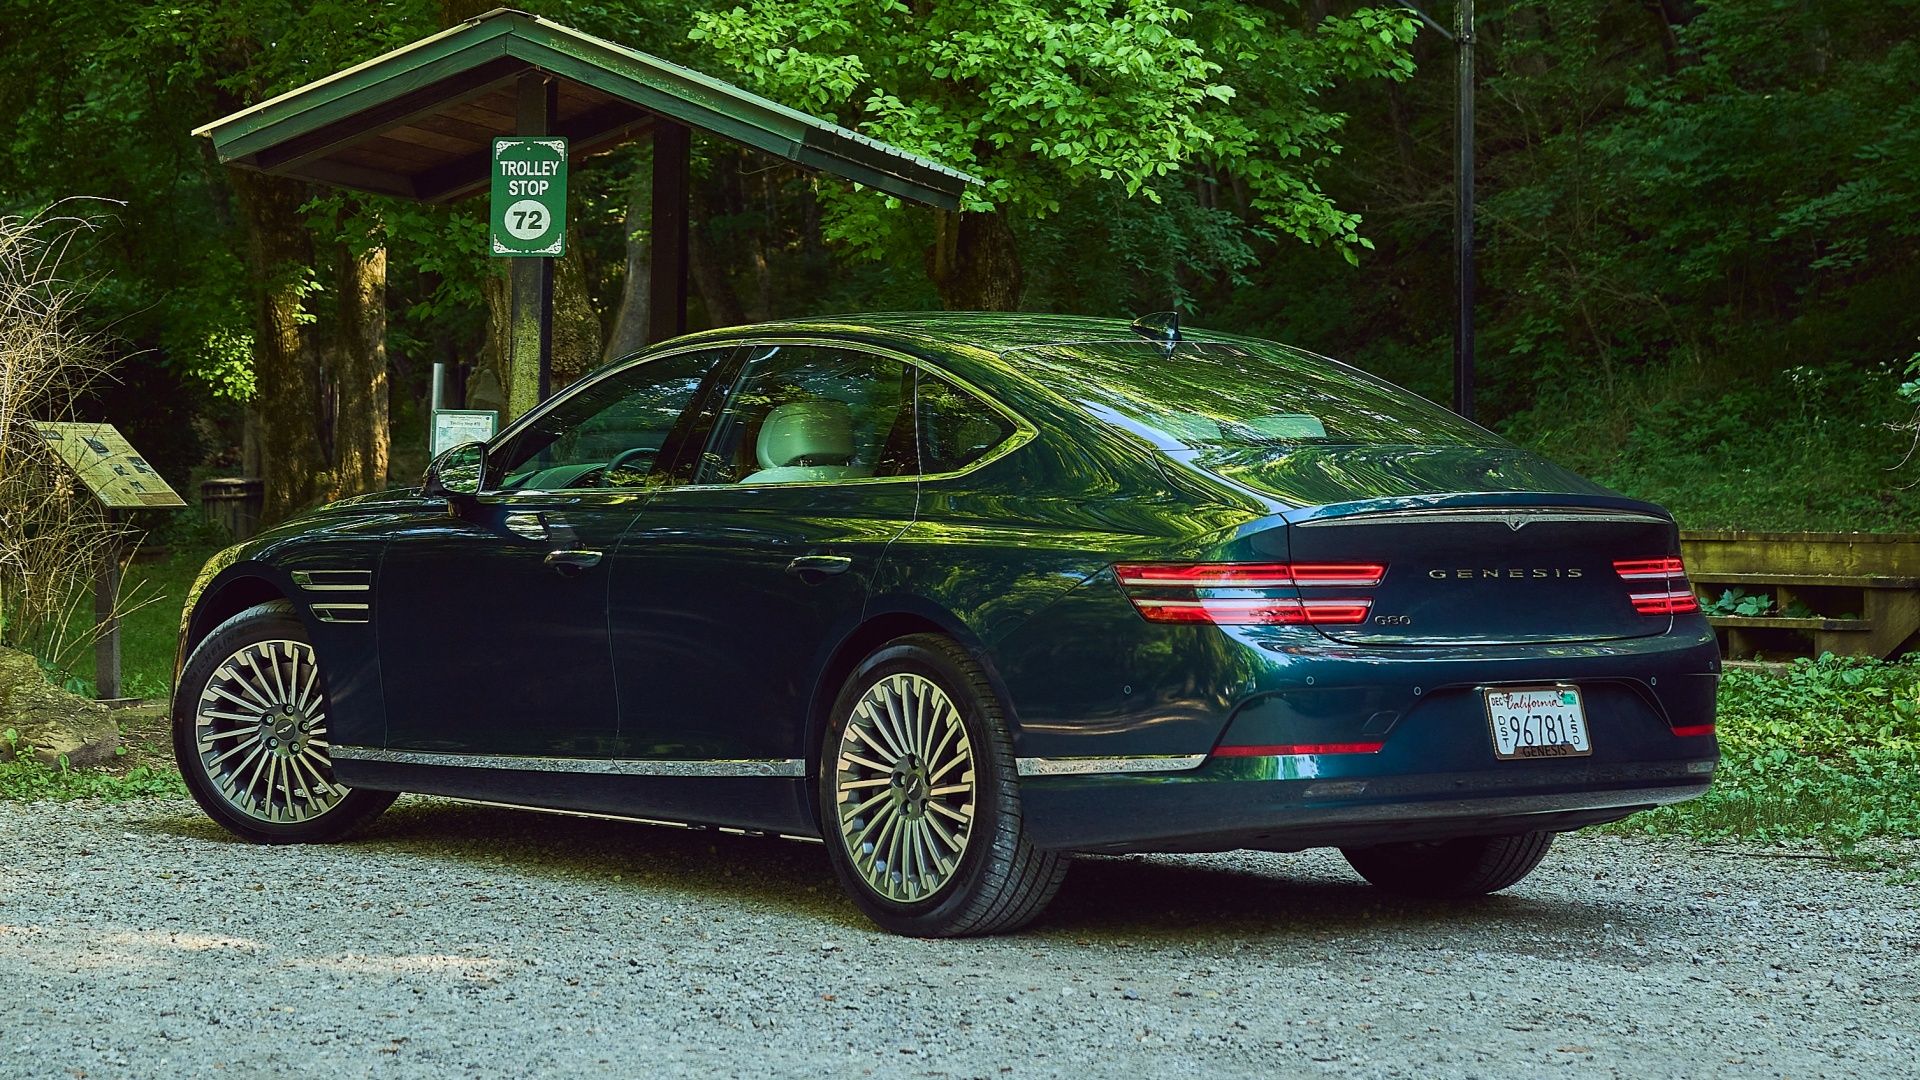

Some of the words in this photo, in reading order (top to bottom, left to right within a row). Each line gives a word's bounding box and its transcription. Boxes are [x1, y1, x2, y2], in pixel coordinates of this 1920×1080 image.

[500, 160, 560, 176] TROLLEY
[508, 180, 549, 196] STOP
[513, 211, 543, 230] 72
[1428, 568, 1583, 579] GENESIS
[1374, 615, 1411, 625] G80
[1491, 696, 1504, 706] DEC
[1506, 694, 1564, 713] California
[1509, 714, 1571, 747] 96781
[1523, 746, 1568, 758] GENESIS
